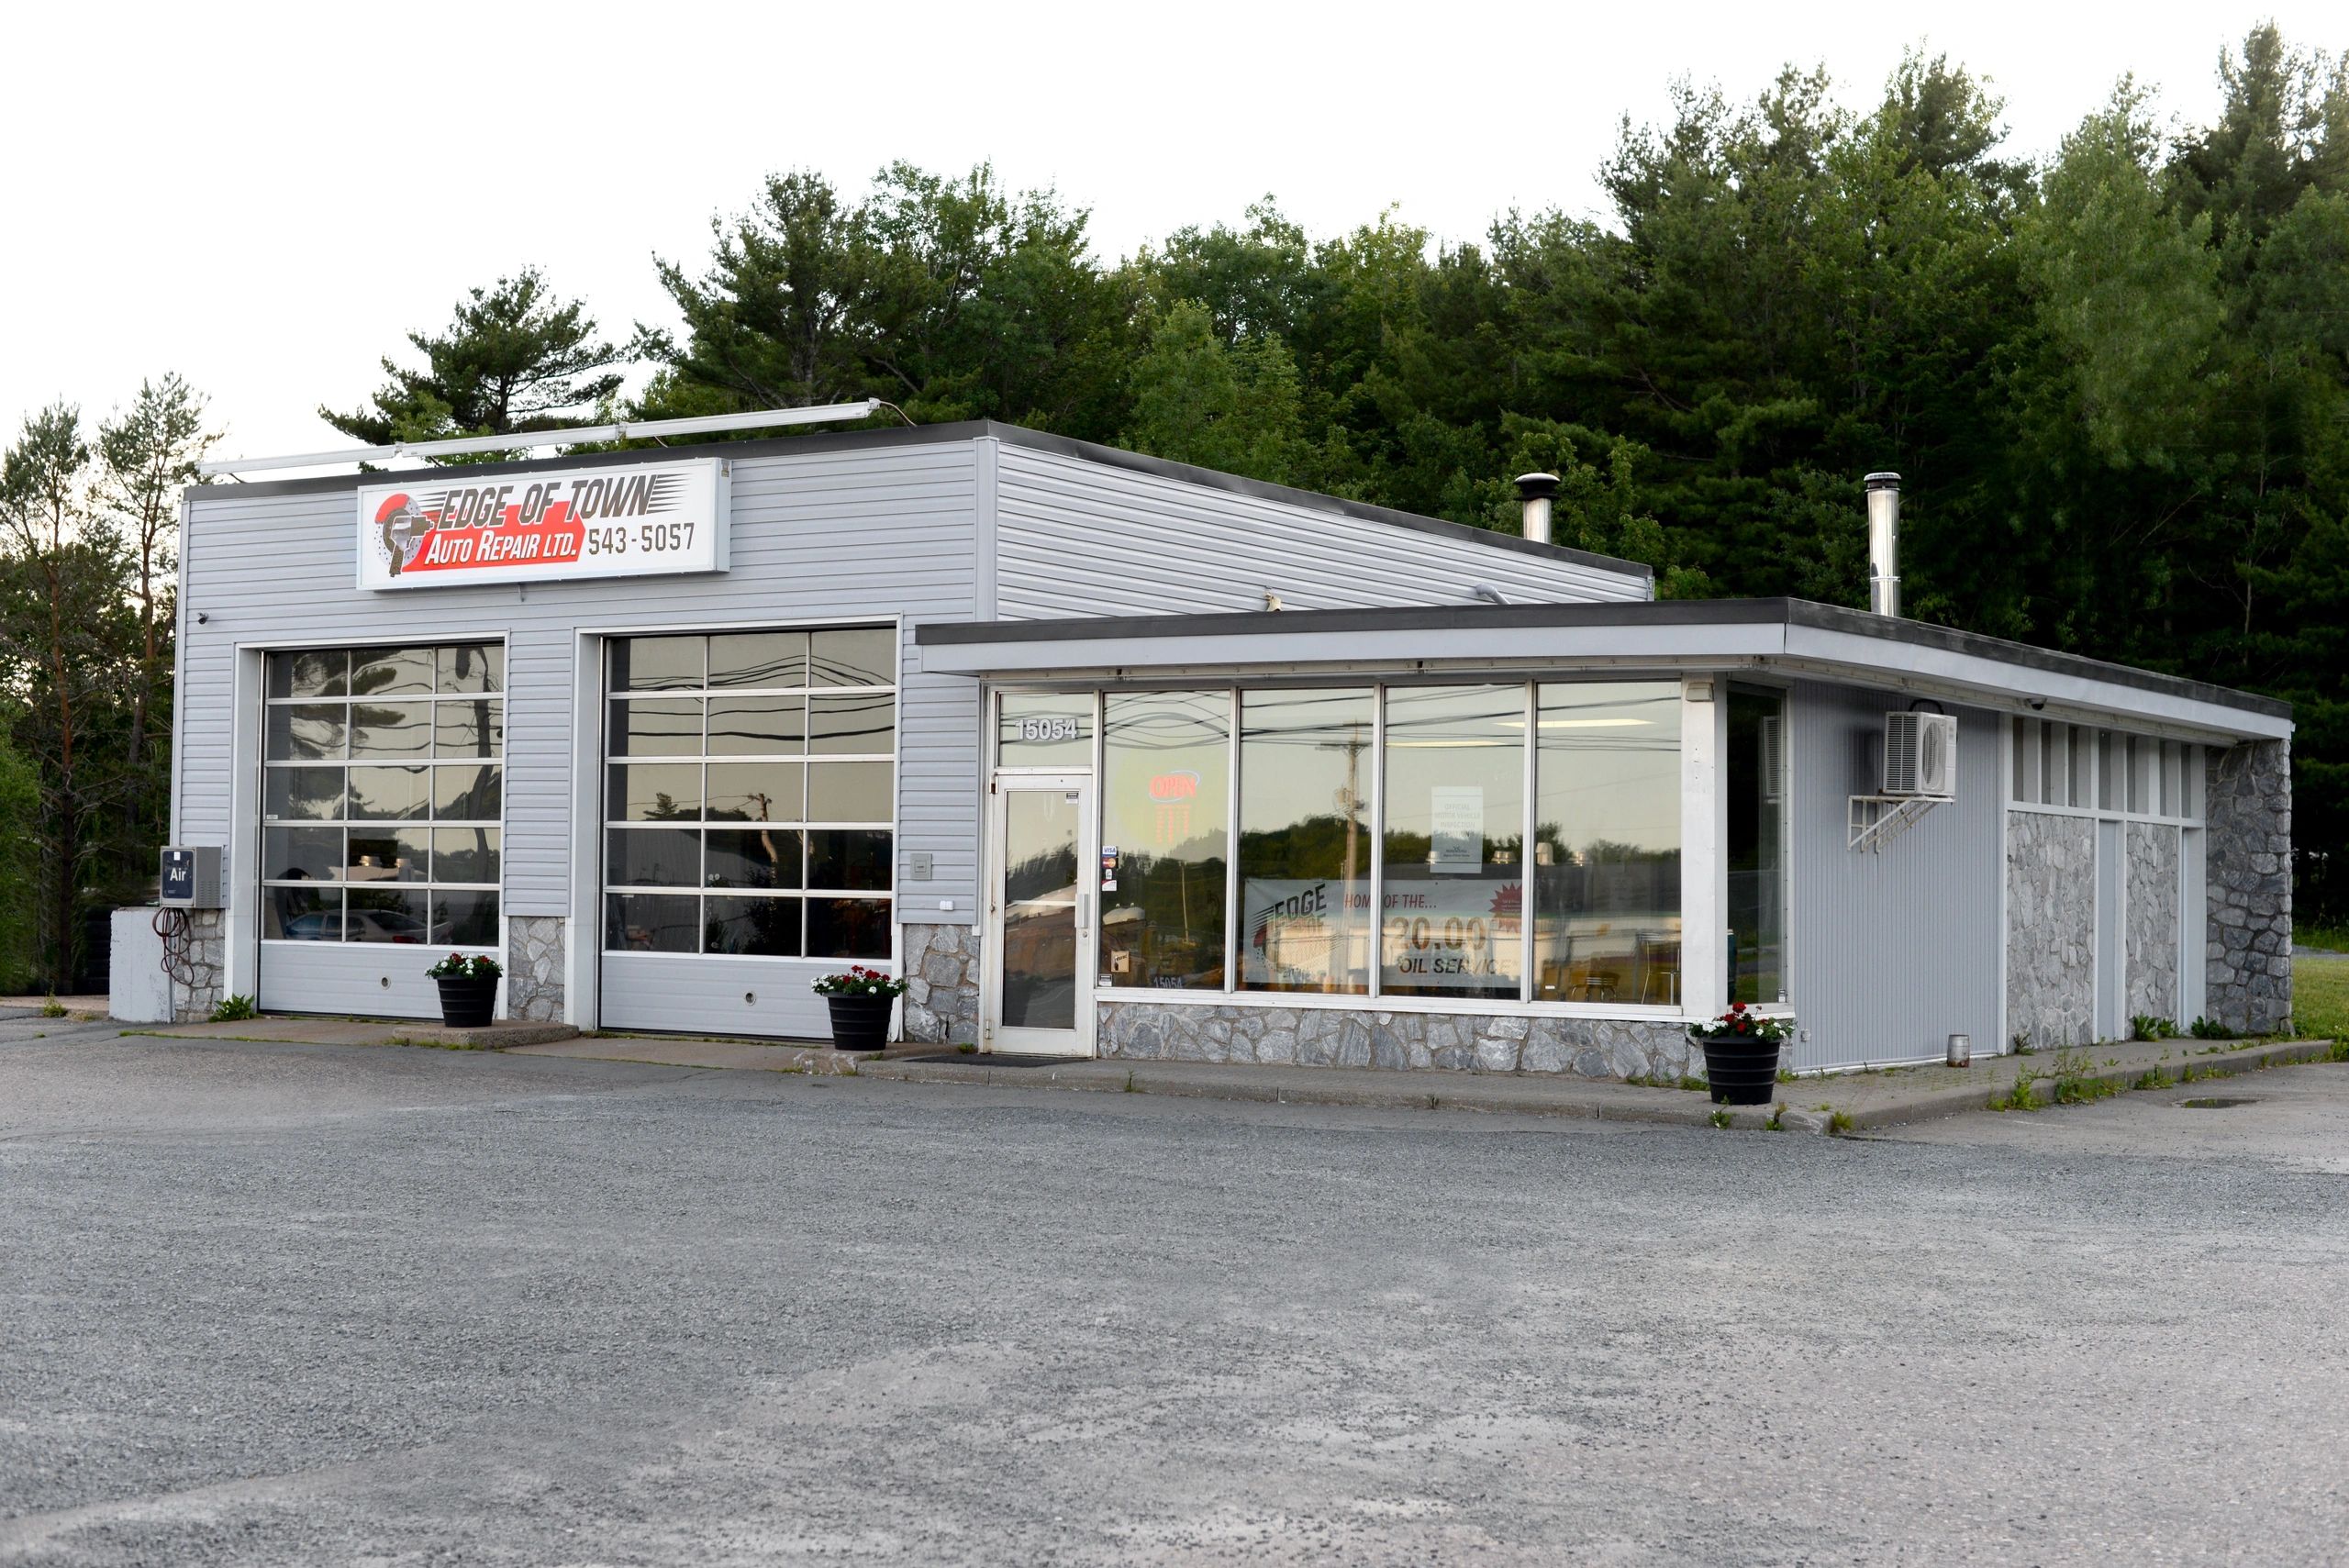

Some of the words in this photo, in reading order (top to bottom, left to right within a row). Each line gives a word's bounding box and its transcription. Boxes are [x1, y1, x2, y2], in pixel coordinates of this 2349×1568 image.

[438, 485, 514, 529] EDGE
[520, 482, 562, 525] OF
[566, 473, 657, 520] TOWN
[1015, 718, 1077, 740] 15054
[1150, 775, 1197, 797] OPEN
[169, 867, 187, 882] Air
[1275, 883, 1327, 921] EDGE
[1344, 893, 1372, 908] HOM
[1383, 894, 1398, 908] OF
[1153, 976, 1183, 989] 15054
